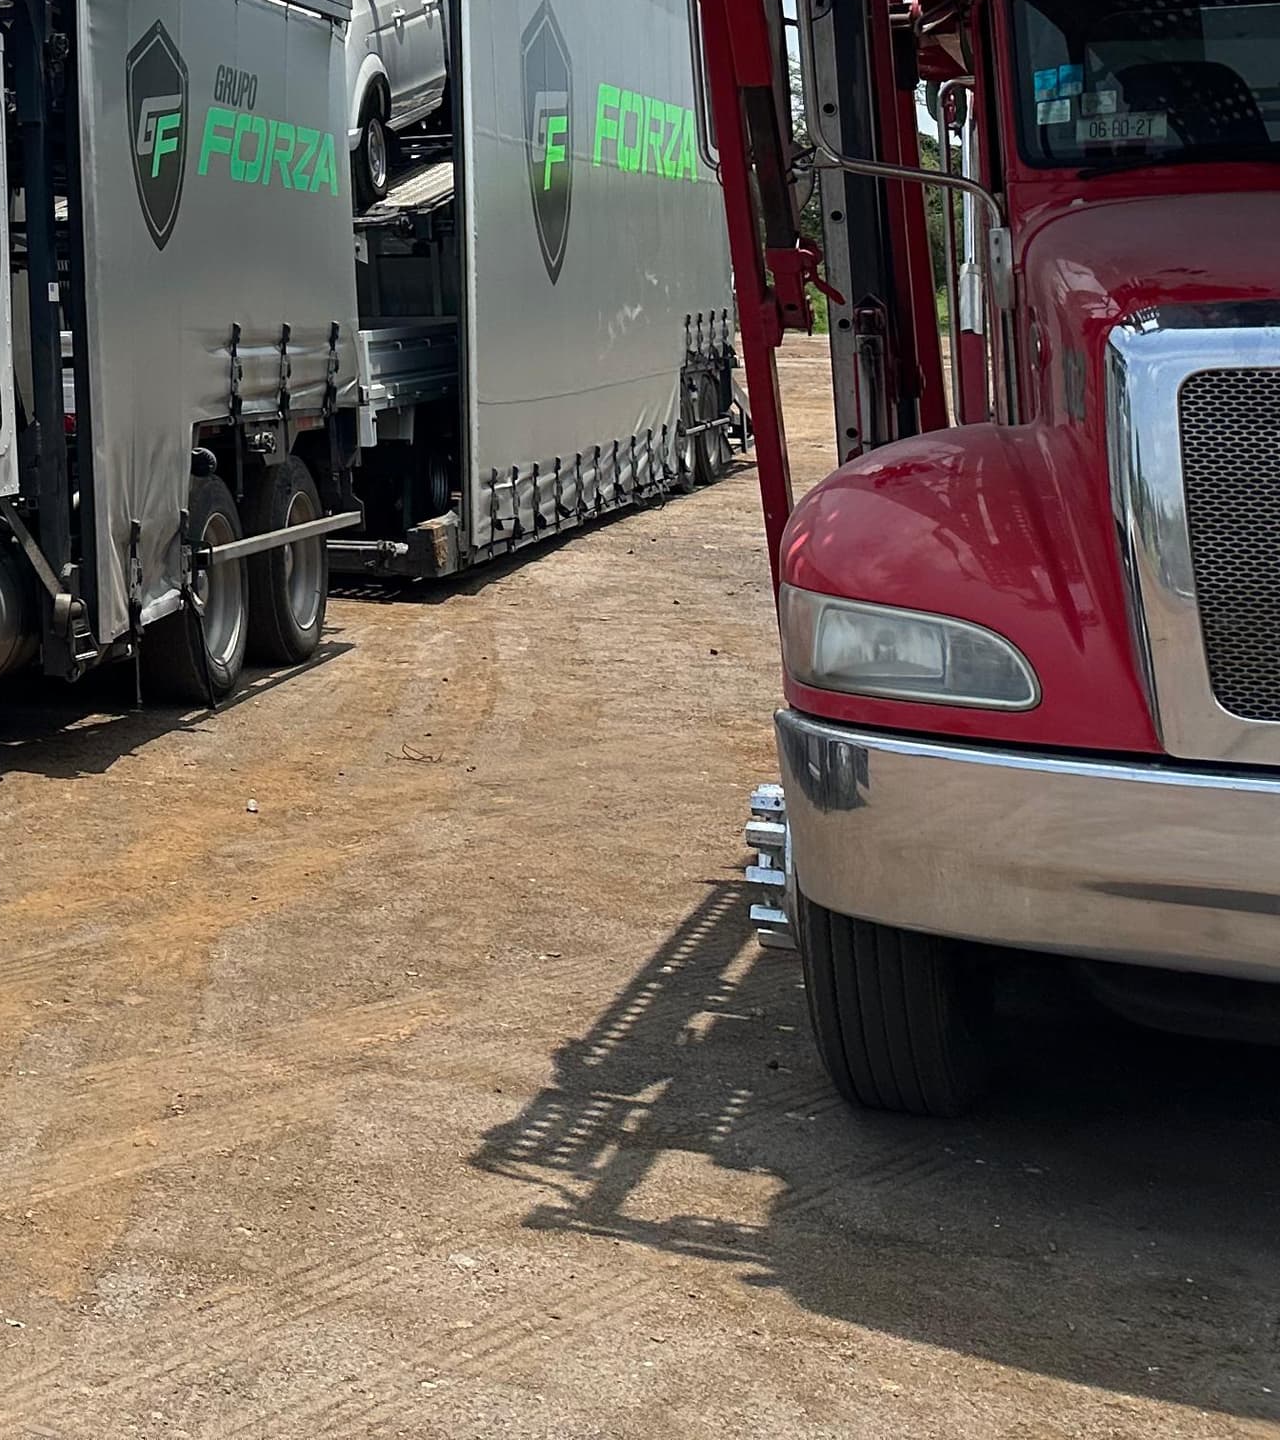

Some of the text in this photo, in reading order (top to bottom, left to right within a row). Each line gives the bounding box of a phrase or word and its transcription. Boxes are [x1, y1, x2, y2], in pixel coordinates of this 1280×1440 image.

[213, 63, 259, 111] GRUPO
[197, 106, 338, 196] FORZA
[592, 82, 698, 183] FORZA
